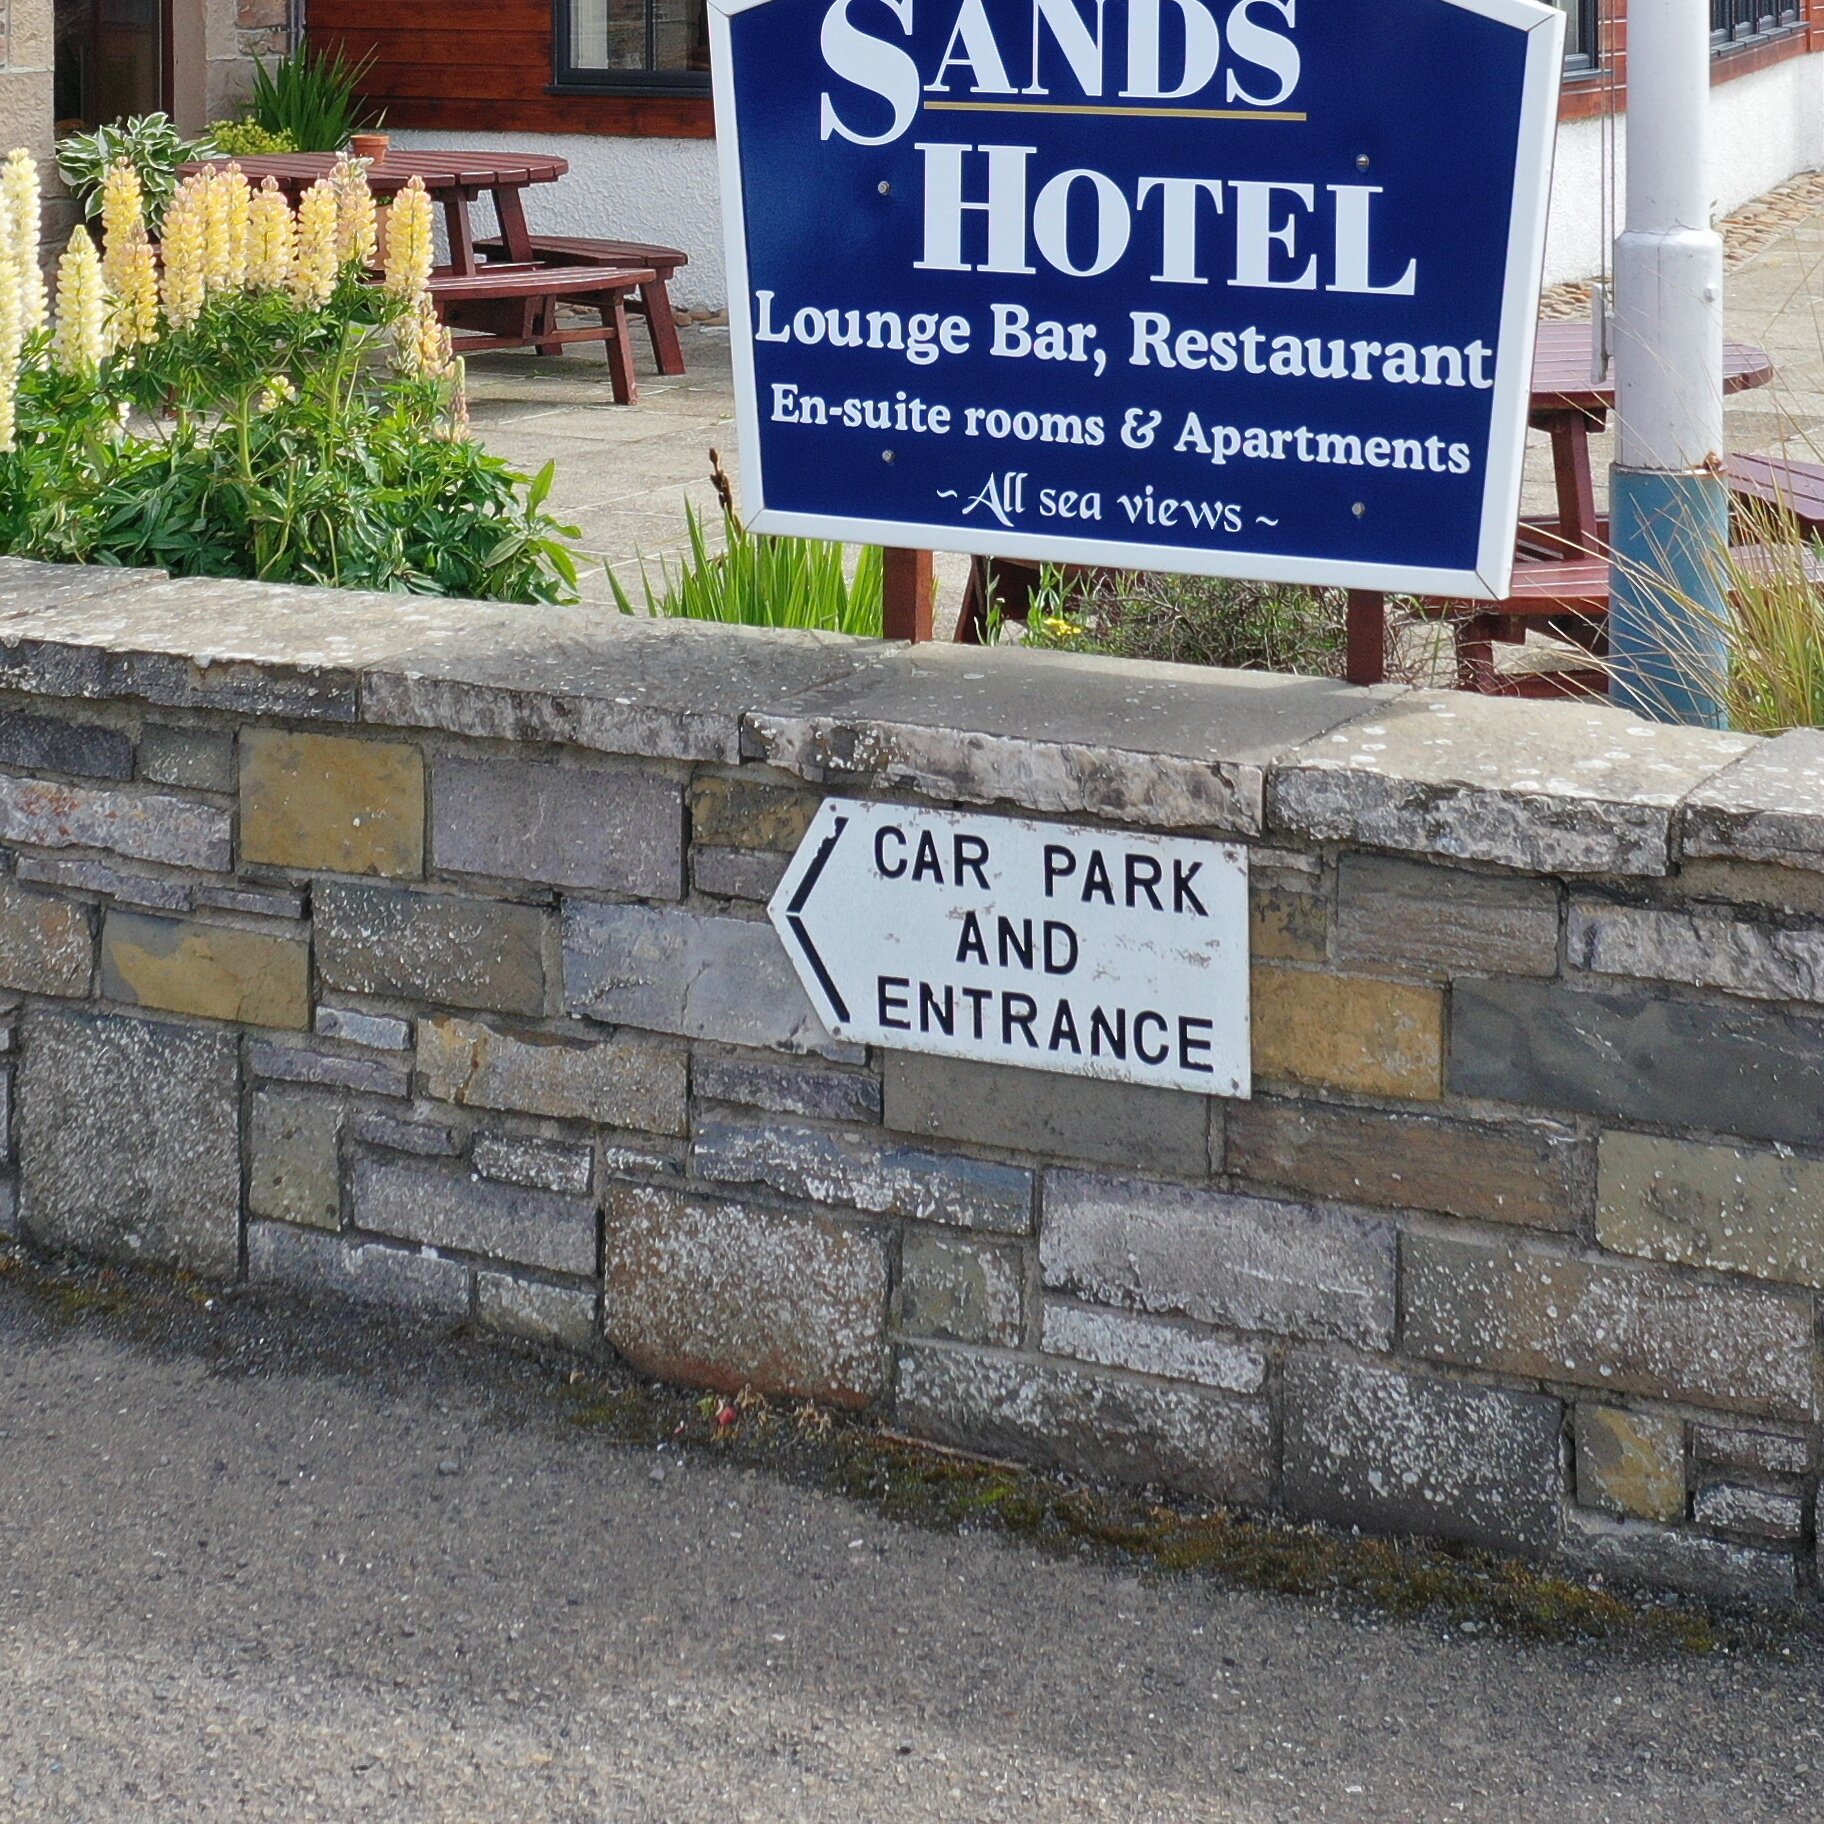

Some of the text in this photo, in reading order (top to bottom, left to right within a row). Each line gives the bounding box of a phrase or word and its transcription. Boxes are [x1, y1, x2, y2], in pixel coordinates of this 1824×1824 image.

[912, 142, 1417, 296] HOTEL
[754, 289, 1494, 389] Lounge Bar, Restaurant
[770, 383, 1471, 474] En-suite rooms & Apartments
[1039, 488, 1102, 521] sea
[1116, 485, 1242, 533] views
[874, 825, 1209, 917] CAR PARK
[955, 910, 1079, 975] AND
[877, 975, 1214, 1073] ENTRANCE
